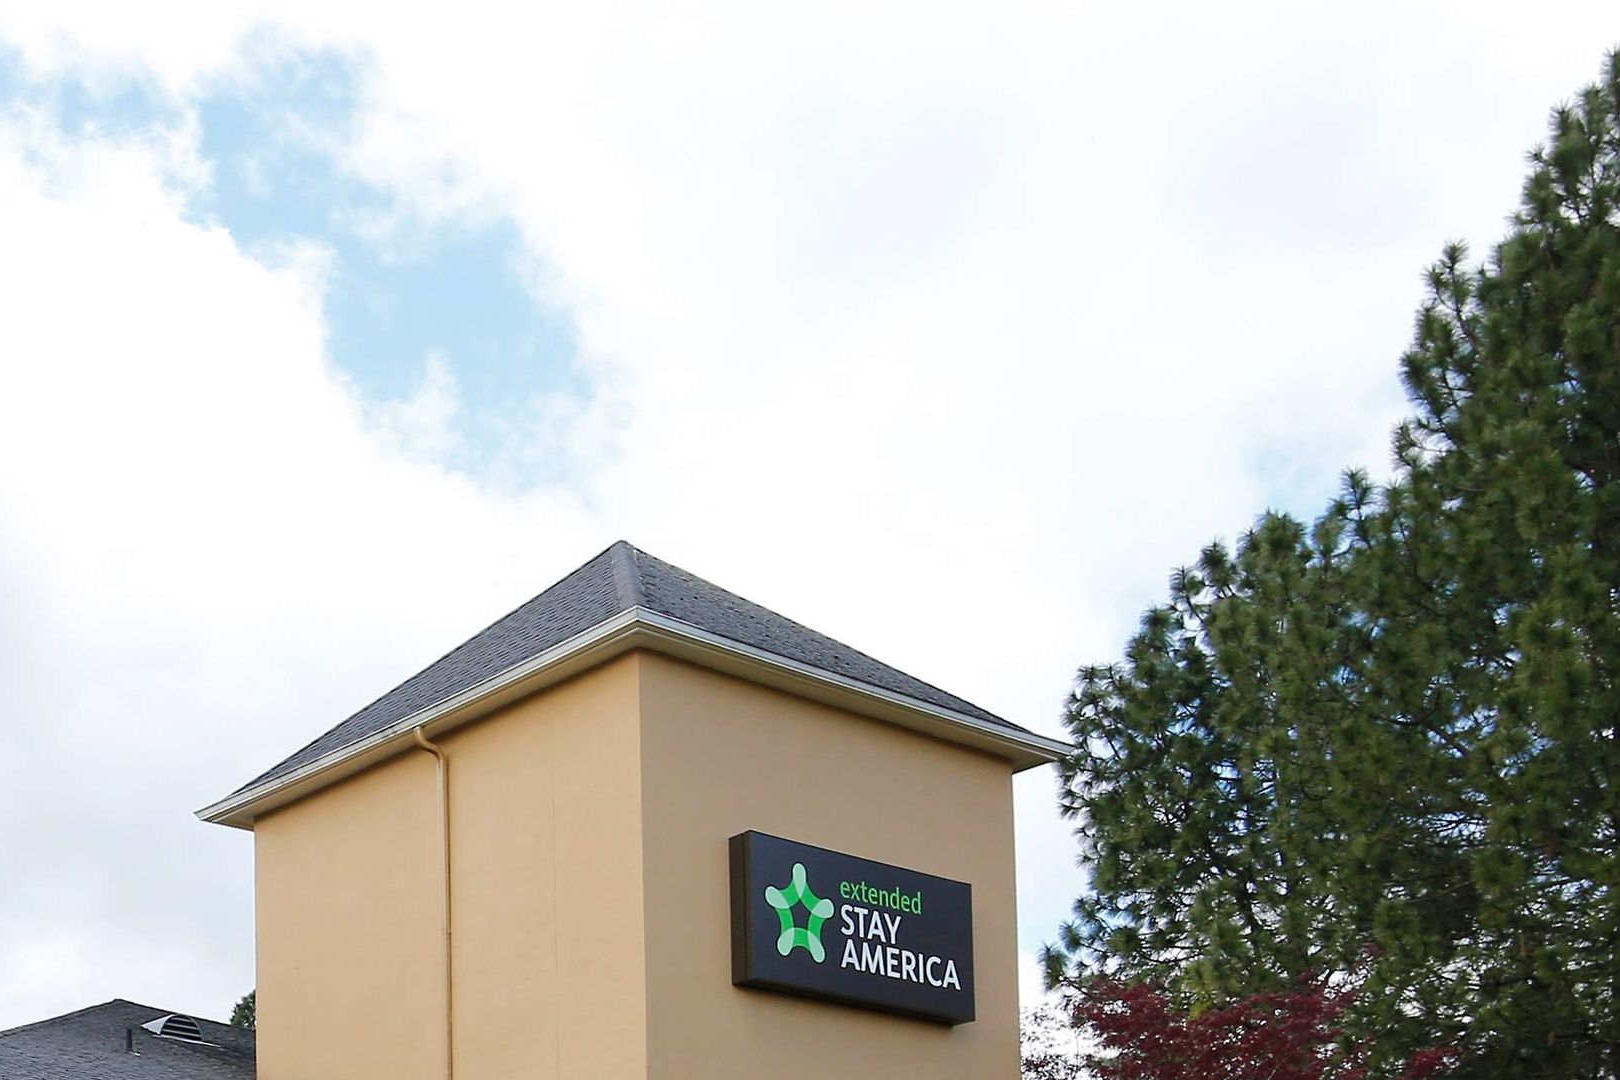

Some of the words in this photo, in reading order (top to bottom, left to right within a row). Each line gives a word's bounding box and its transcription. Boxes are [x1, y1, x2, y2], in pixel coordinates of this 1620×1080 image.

[840, 881, 922, 915] extended
[840, 904, 901, 944] STAY
[841, 939, 961, 991] AMERICA
